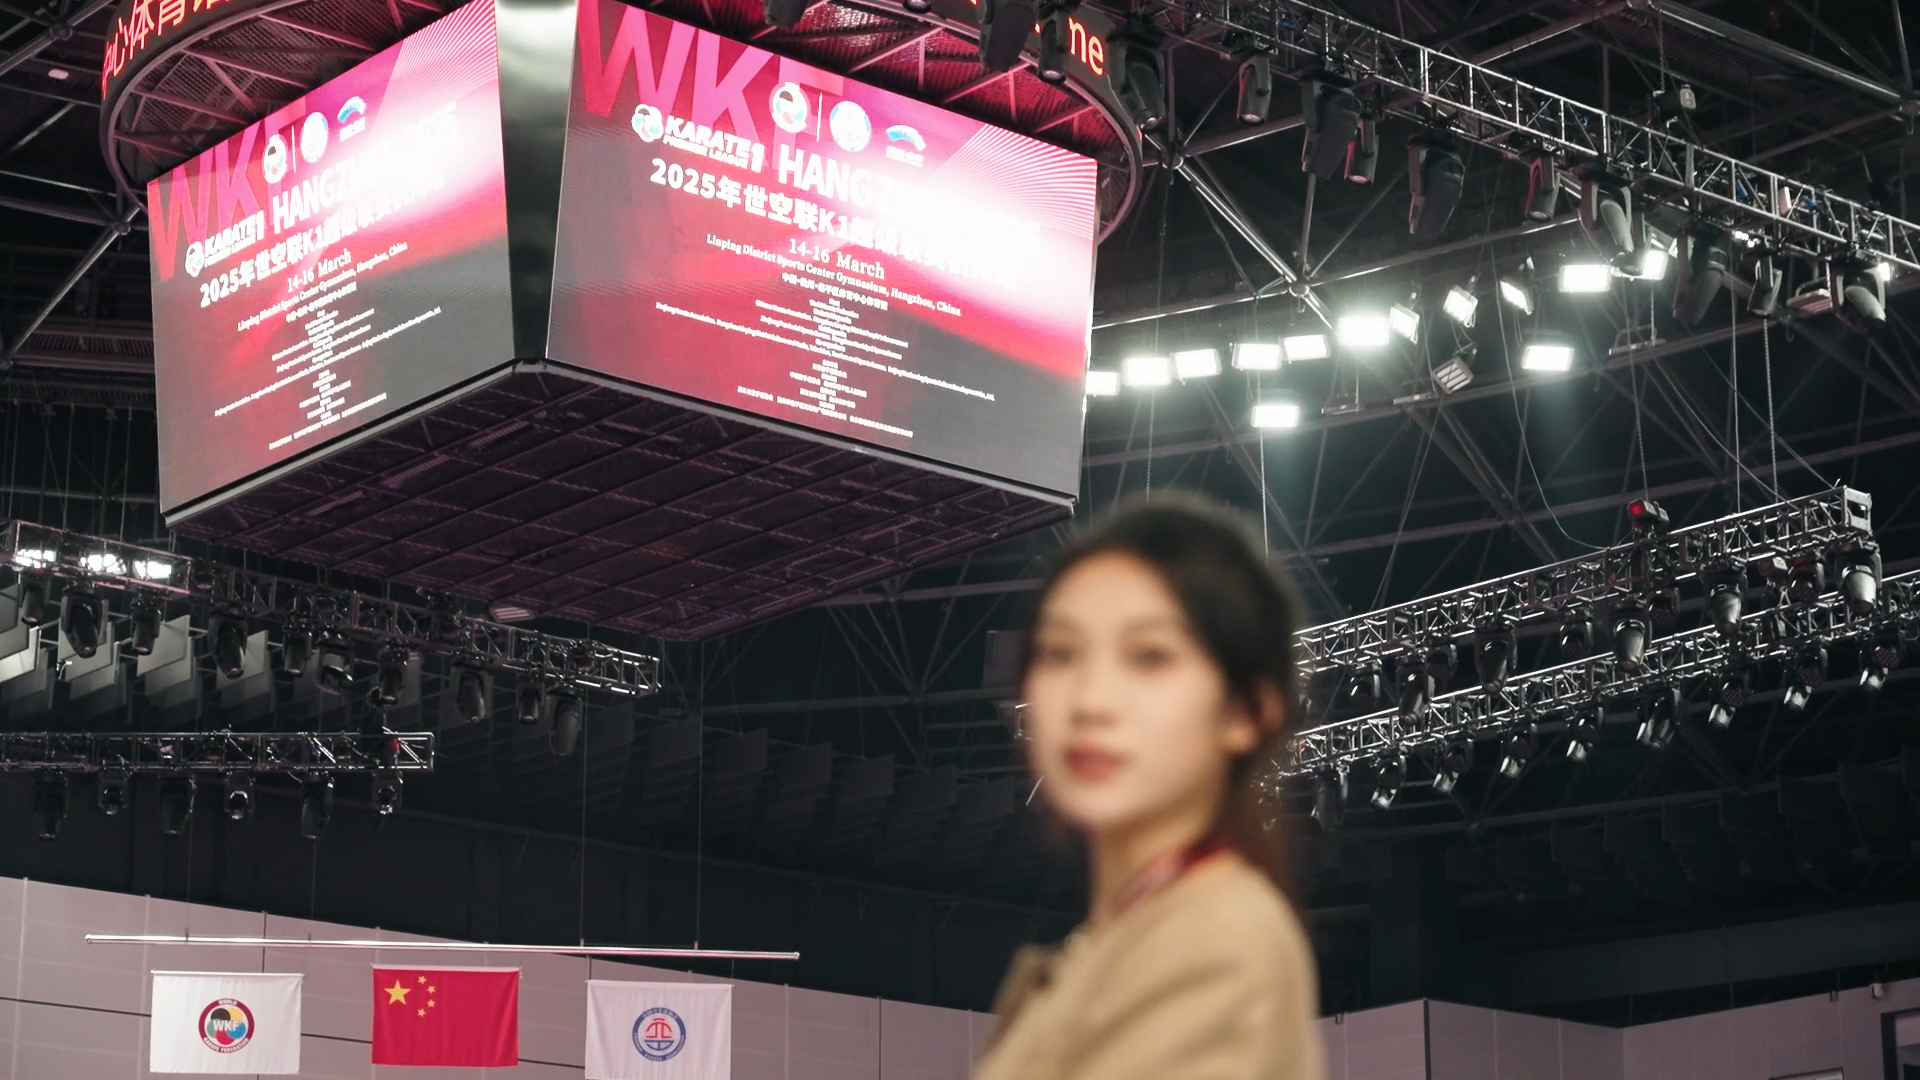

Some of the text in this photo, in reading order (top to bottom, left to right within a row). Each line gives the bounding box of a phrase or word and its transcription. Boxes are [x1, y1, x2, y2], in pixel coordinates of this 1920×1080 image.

[287, 248, 352, 293] 14-16 March
[706, 234, 741, 255] Linping
[742, 245, 776, 263] District
[776, 255, 805, 272] Sports
[805, 263, 835, 280] Center
[835, 271, 890, 298] Gymnasium,
[936, 301, 962, 317] China
[788, 239, 886, 280] 14-16 March
[213, 1019, 240, 1031] WKF
